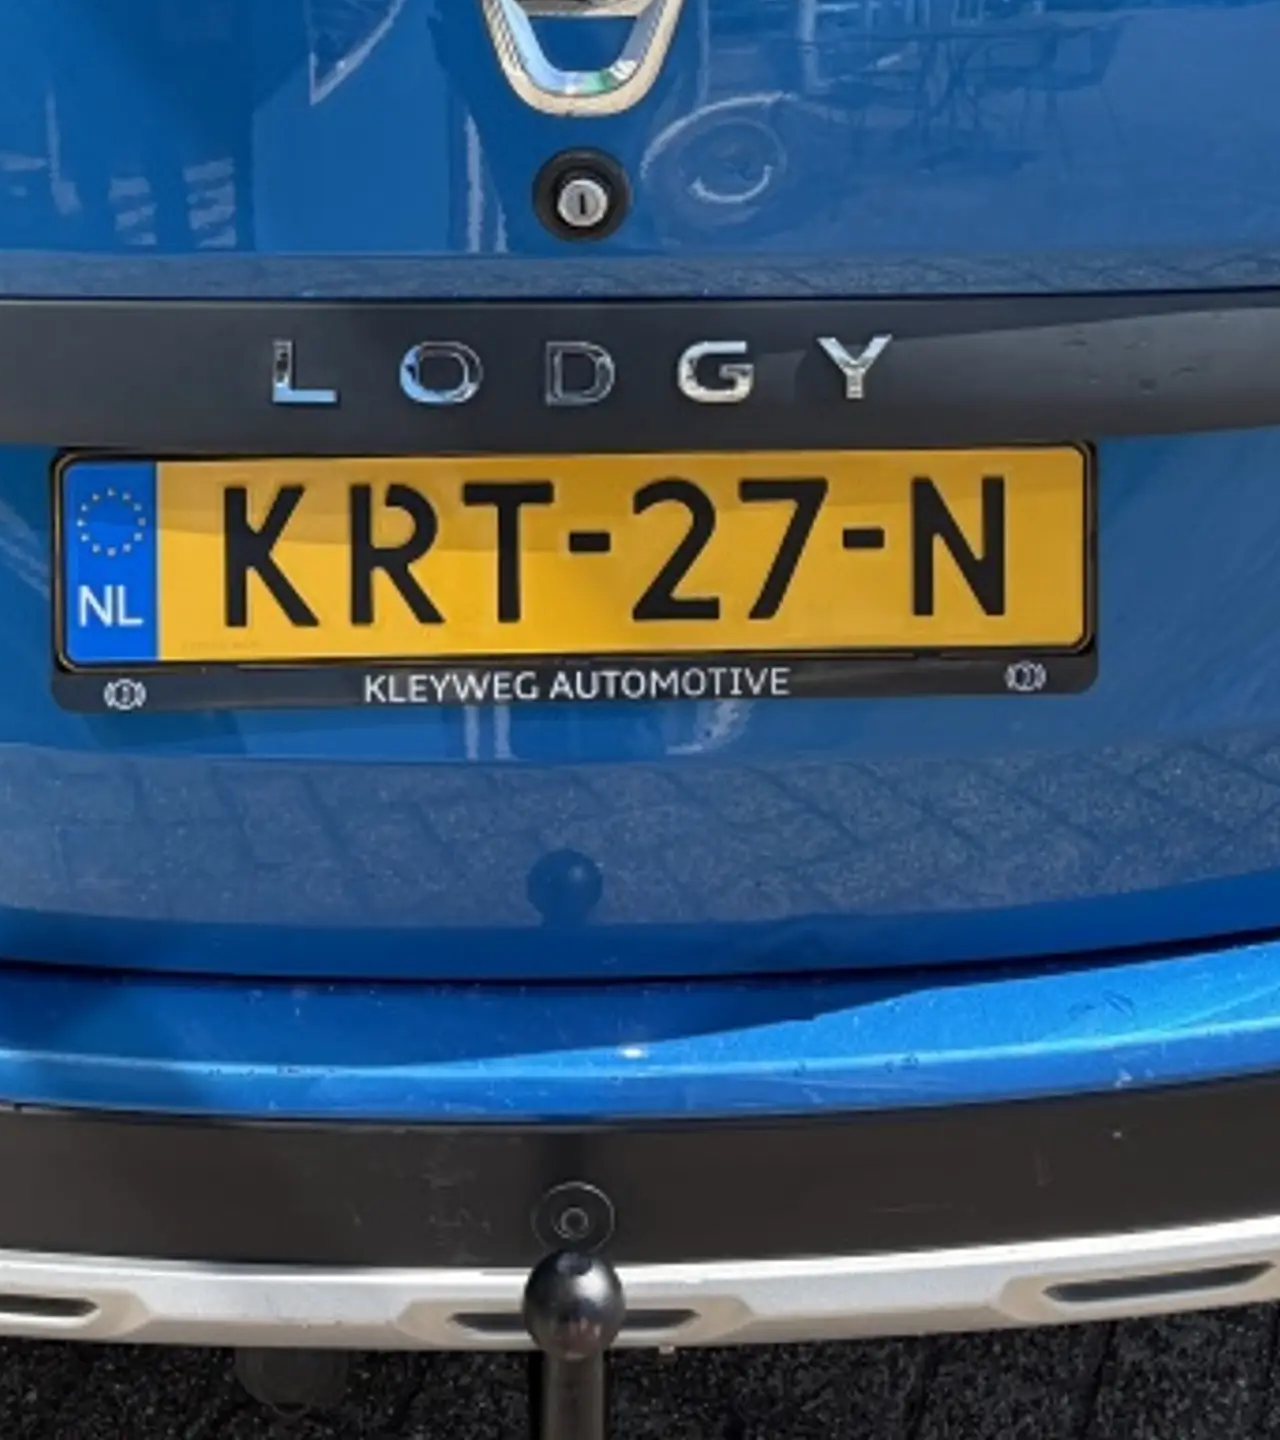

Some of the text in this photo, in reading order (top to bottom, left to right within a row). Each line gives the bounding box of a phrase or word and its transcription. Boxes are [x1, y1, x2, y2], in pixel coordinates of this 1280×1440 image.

[270, 334, 894, 406] LODGY
[222, 475, 1008, 630] KRT-27-N
[77, 584, 145, 628] NL
[363, 667, 791, 703] KLEYWEG AUTOMOTIVE
